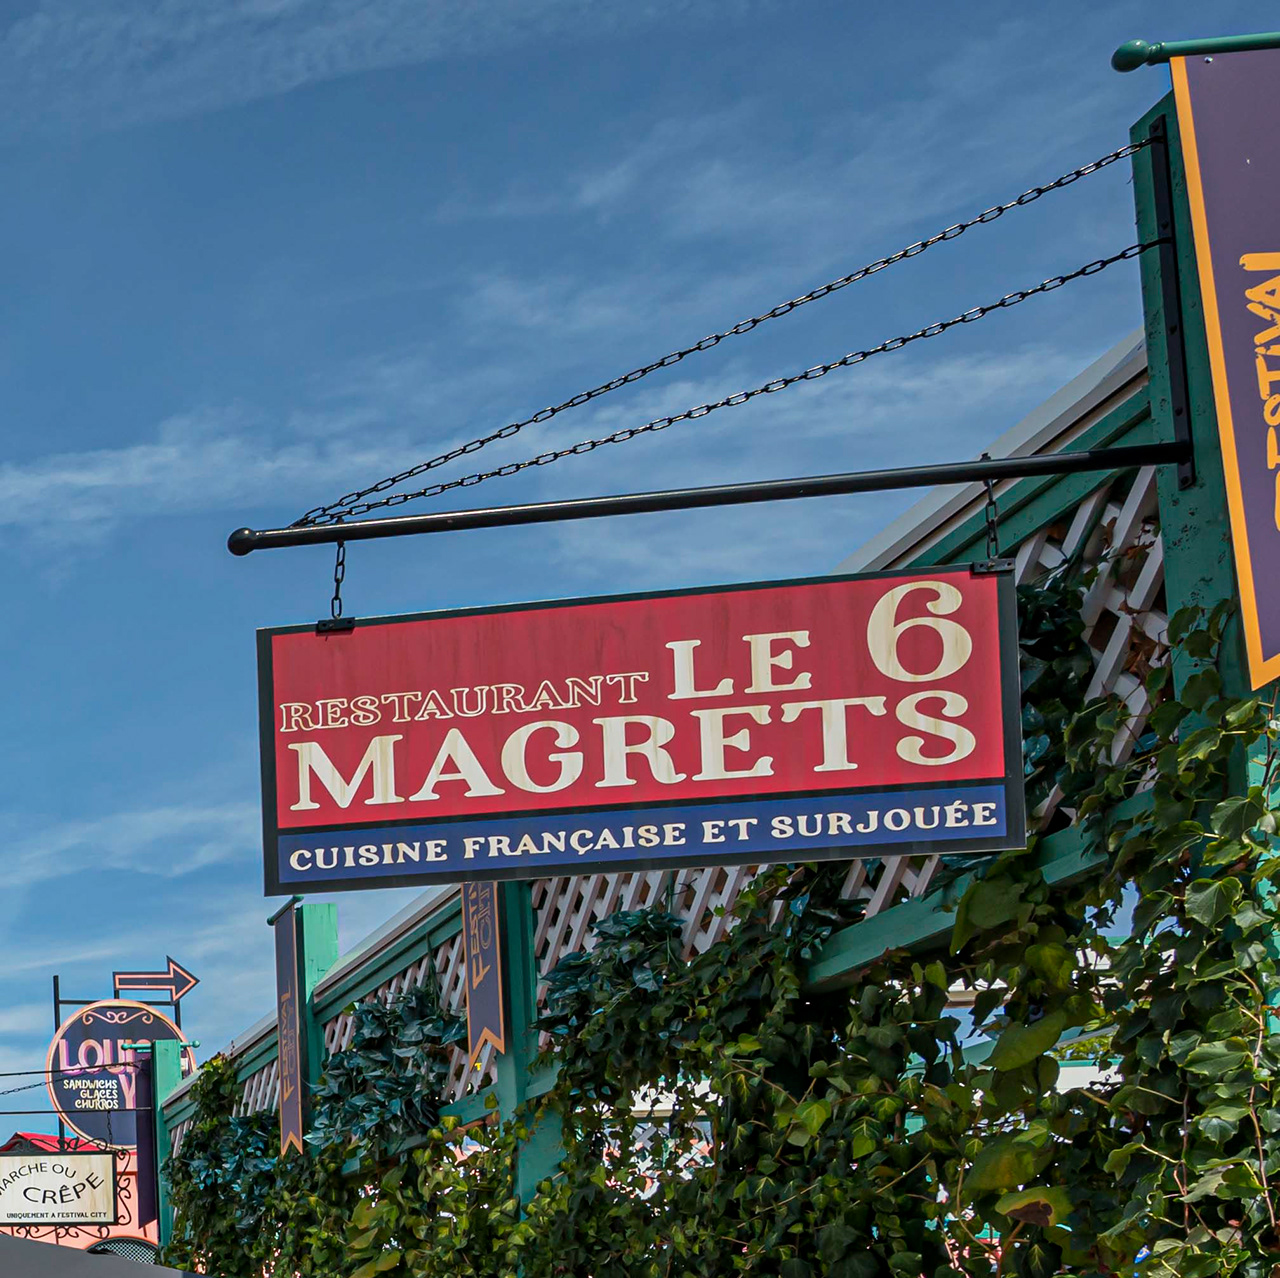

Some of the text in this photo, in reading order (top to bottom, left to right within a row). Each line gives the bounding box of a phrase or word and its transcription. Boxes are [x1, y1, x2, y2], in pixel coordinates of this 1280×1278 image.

[280, 579, 973, 734] RESTAURANT LE 6
[285, 688, 978, 812] MAGRETS
[289, 800, 998, 873] CUISINE FRANÇAISE ET SURJOUÉE
[63, 1079, 118, 1090] SANDWICHS
[80, 1090, 118, 1100] GLACES
[75, 1099, 119, 1110] CHURROS
[52, 1163, 77, 1179] OU
[23, 1172, 105, 1205] CRÊPE
